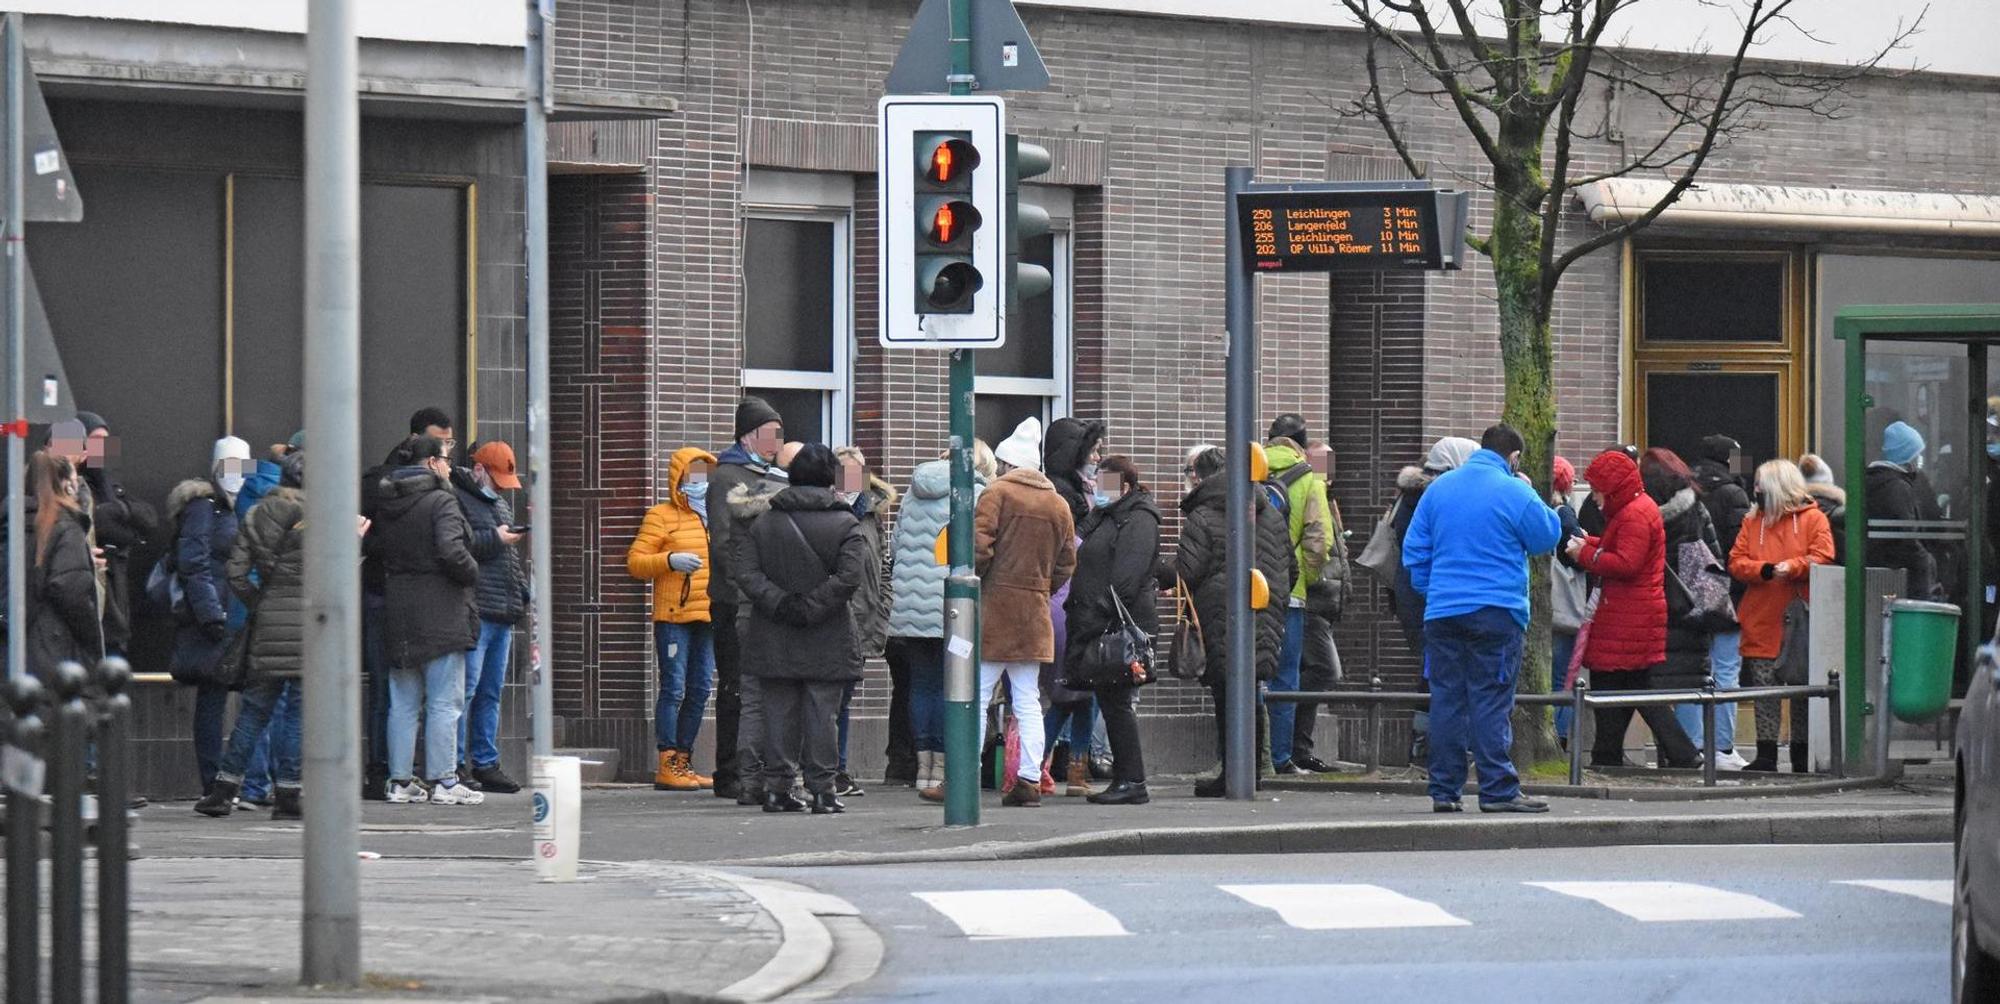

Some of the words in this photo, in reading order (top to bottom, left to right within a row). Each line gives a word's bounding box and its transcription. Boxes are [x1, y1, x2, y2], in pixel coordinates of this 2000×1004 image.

[1253, 210, 1272, 219] 250
[1287, 209, 1350, 220] Leichlingen
[1384, 208, 1391, 217] 3
[1396, 208, 1416, 217] Min
[1254, 221, 1273, 231] 206
[1288, 221, 1346, 232] Langenfeld
[1385, 219, 1392, 229] 5
[1397, 220, 1418, 229] Min
[1255, 233, 1274, 243] 255
[1289, 233, 1353, 244] Leichlingen
[1381, 231, 1393, 241] 10
[1398, 231, 1418, 240] Min
[1256, 245, 1275, 254] 202
[1291, 244, 1303, 254] OP
[1309, 243, 1335, 254] Villa
[1340, 243, 1372, 253] Römer
[1382, 243, 1393, 253] 11
[1400, 242, 1420, 252] Min
